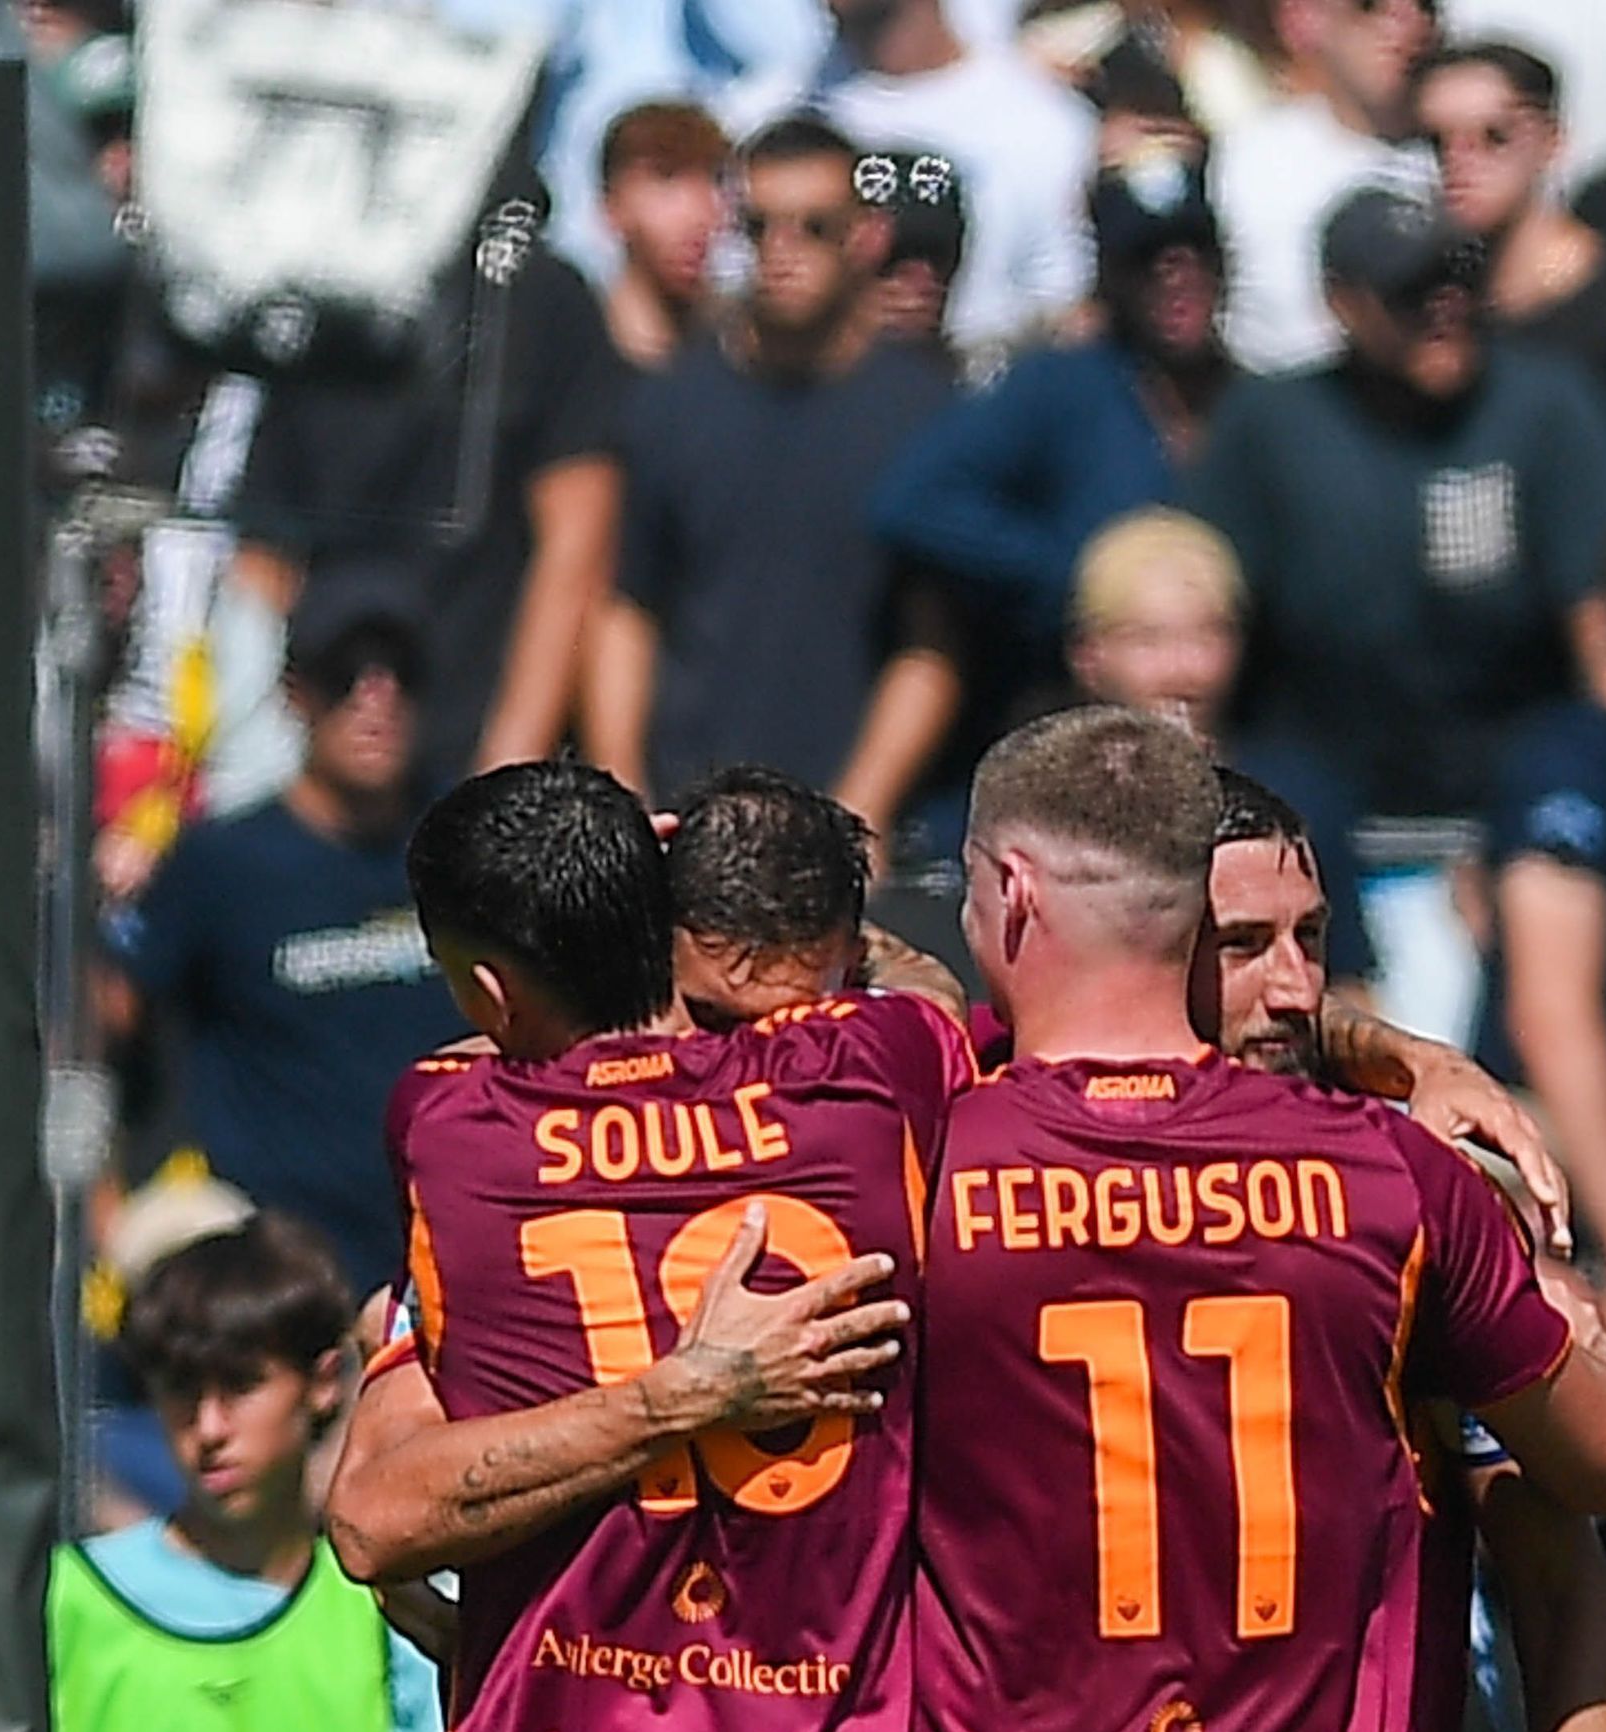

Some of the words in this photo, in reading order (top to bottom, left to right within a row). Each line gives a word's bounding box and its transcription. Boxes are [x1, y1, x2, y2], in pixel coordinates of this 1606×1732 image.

[534, 1082, 790, 1184] SOULE
[950, 1160, 1348, 1252] FERGUSON
[1037, 1295, 1299, 1640] 11
[678, 1643, 851, 1696] Collectio
